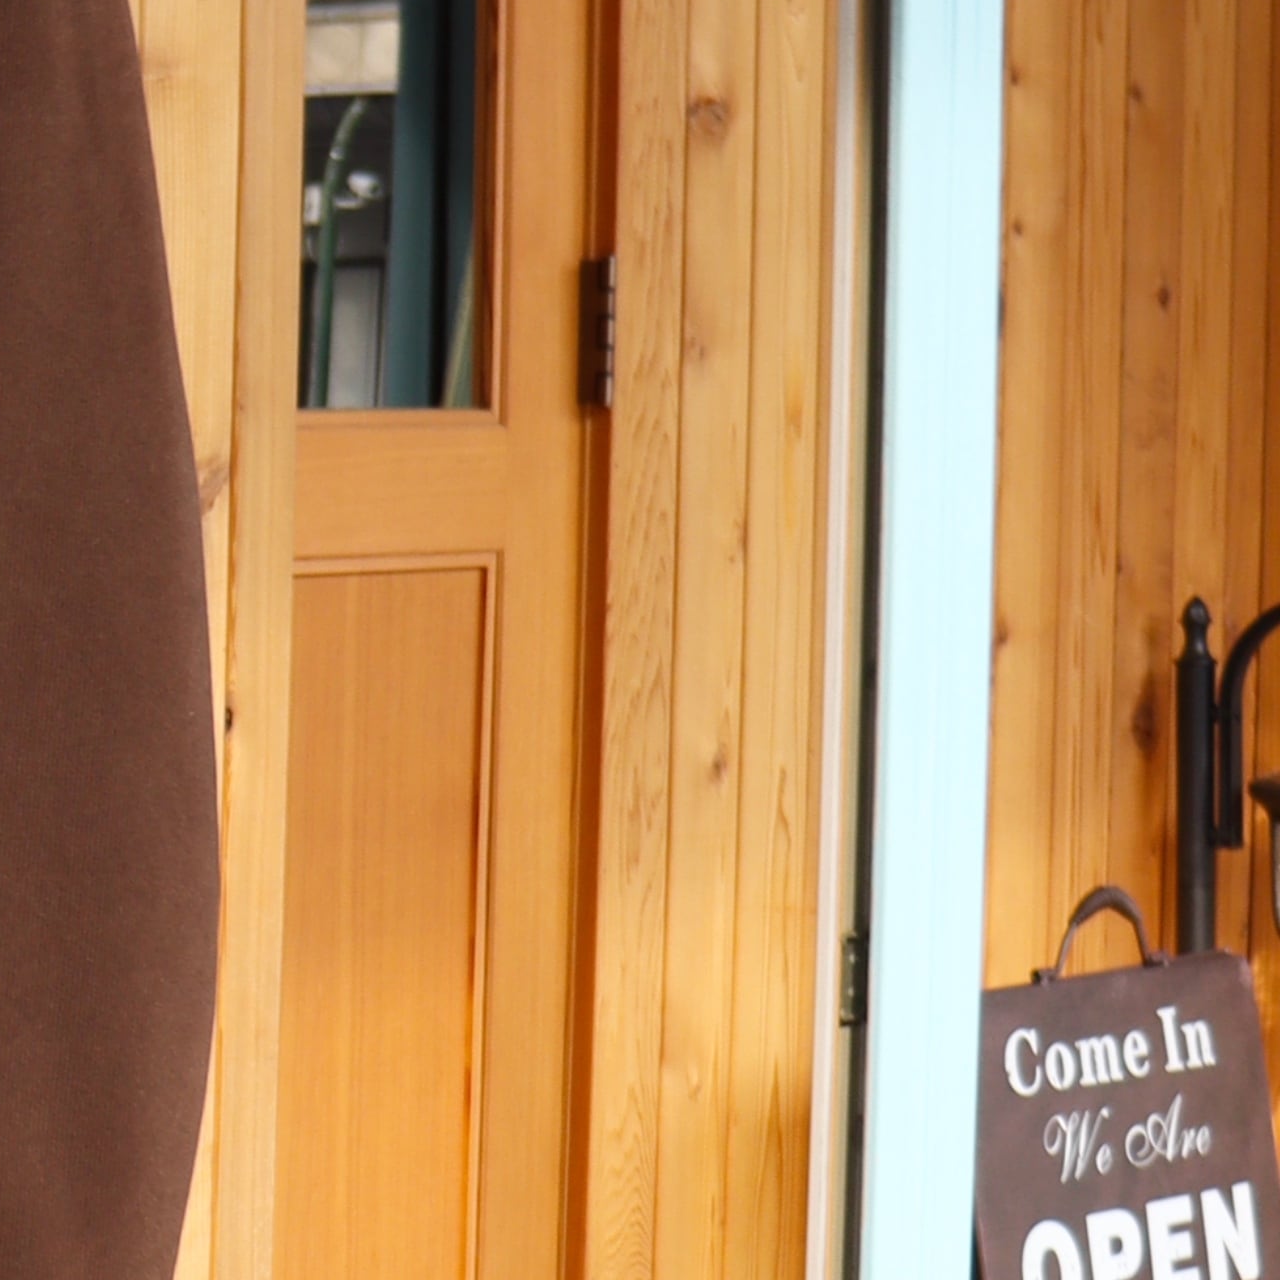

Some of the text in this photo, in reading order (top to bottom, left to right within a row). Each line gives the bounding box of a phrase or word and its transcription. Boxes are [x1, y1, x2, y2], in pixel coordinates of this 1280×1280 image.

[1003, 1005, 1217, 1098] Come In
[1042, 1092, 1212, 1185] We Are
